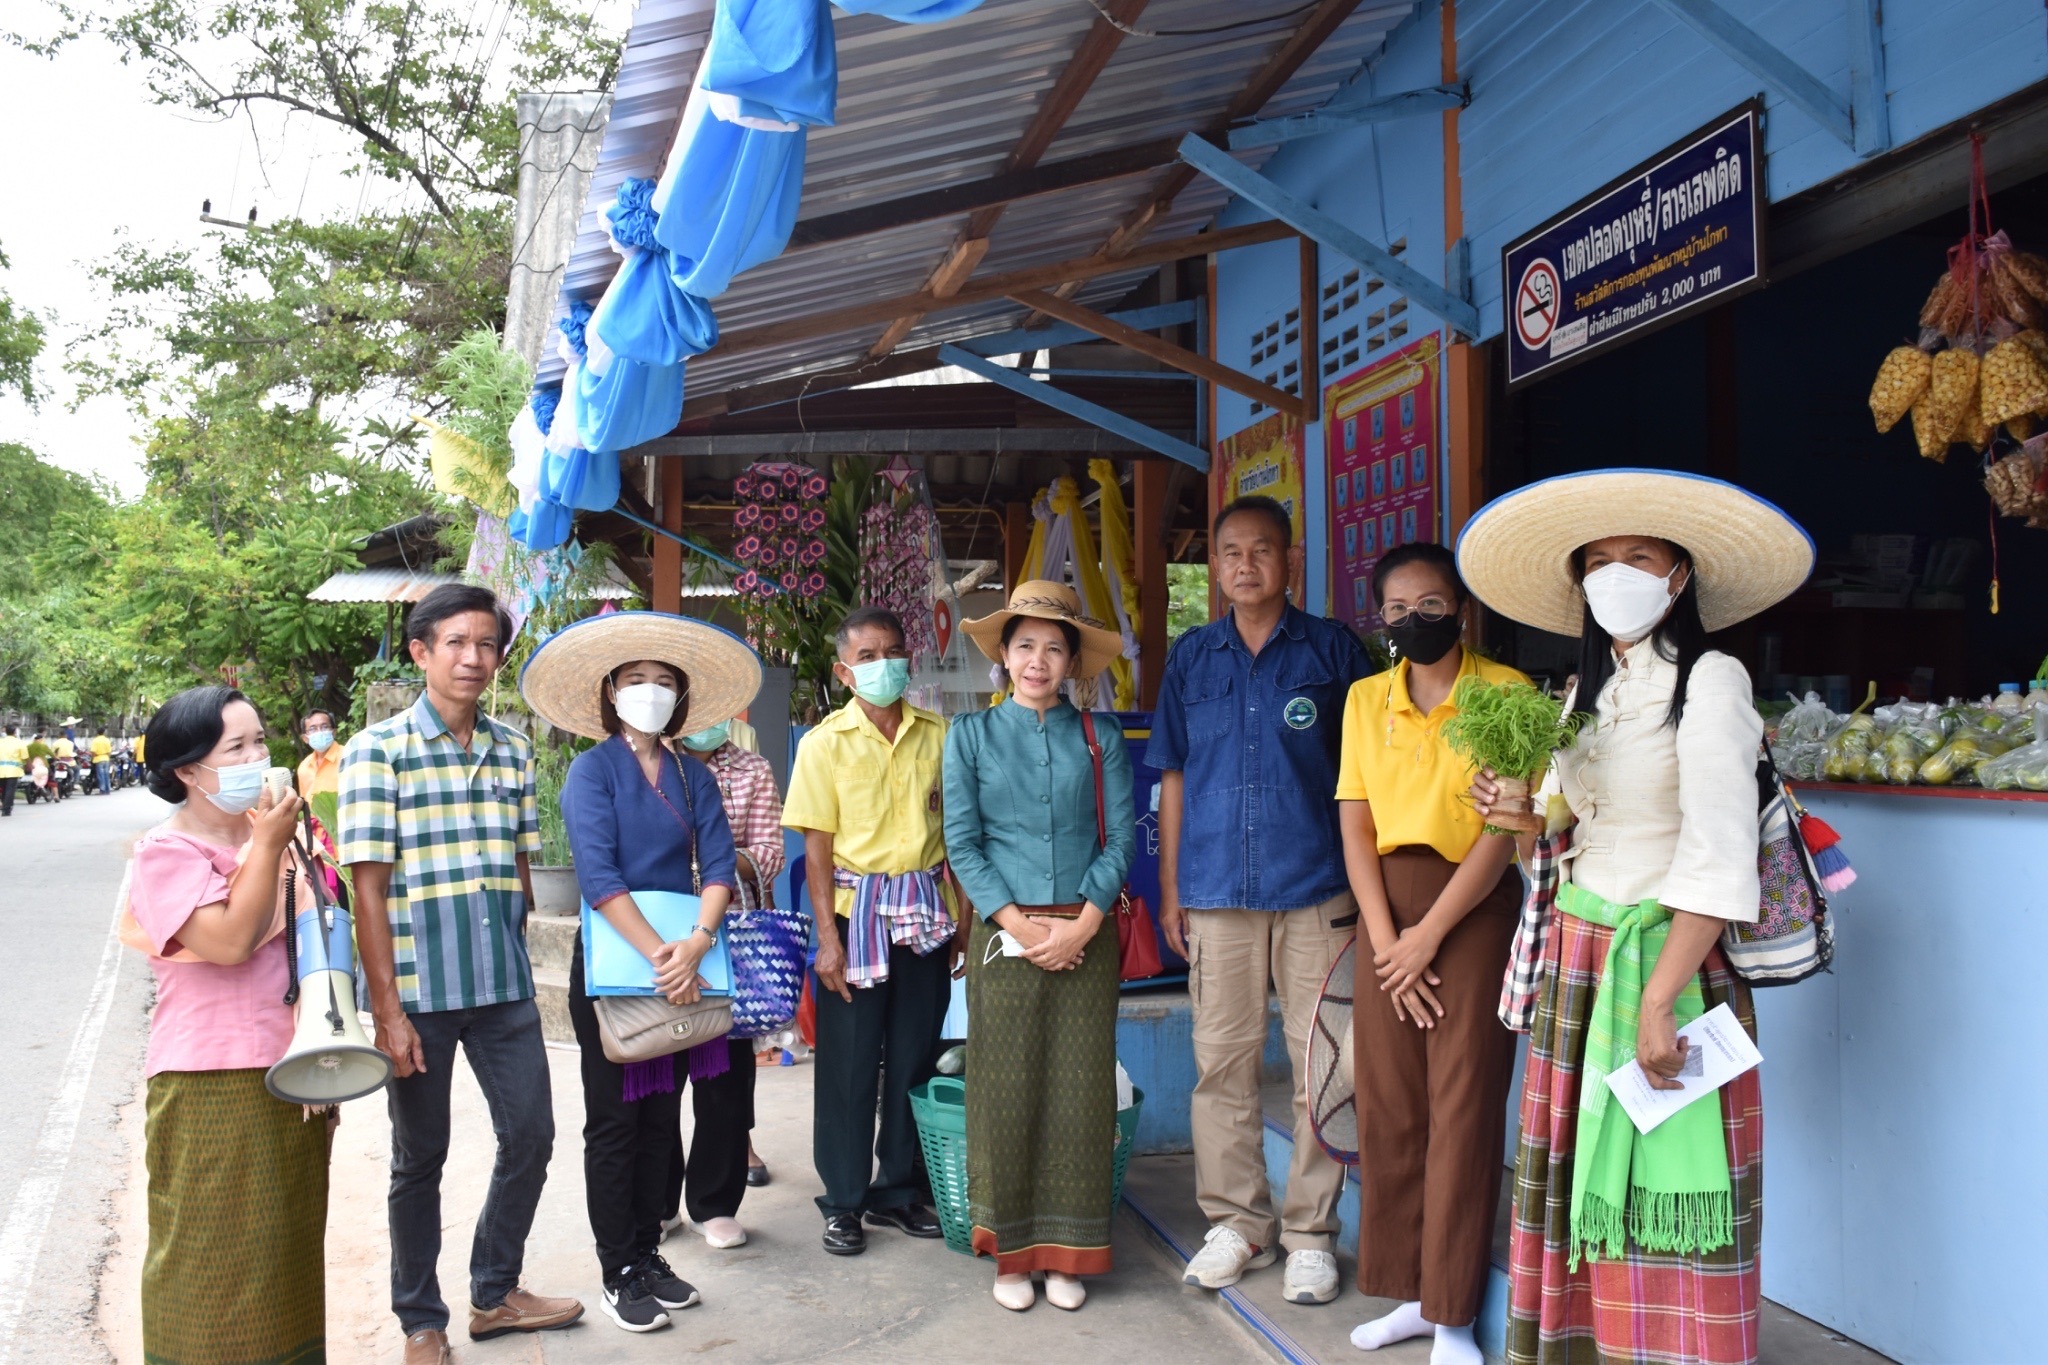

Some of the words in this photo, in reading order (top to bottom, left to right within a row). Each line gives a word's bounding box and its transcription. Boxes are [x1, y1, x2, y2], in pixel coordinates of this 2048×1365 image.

[1562, 146, 1742, 282] เขตปลอดบุหรี่/สารเสพติด
[1589, 294, 1657, 338] ฝ่าฝืนมีโทษปรับ
[1661, 275, 1695, 306] 2,000
[1700, 265, 1721, 288] บาท
